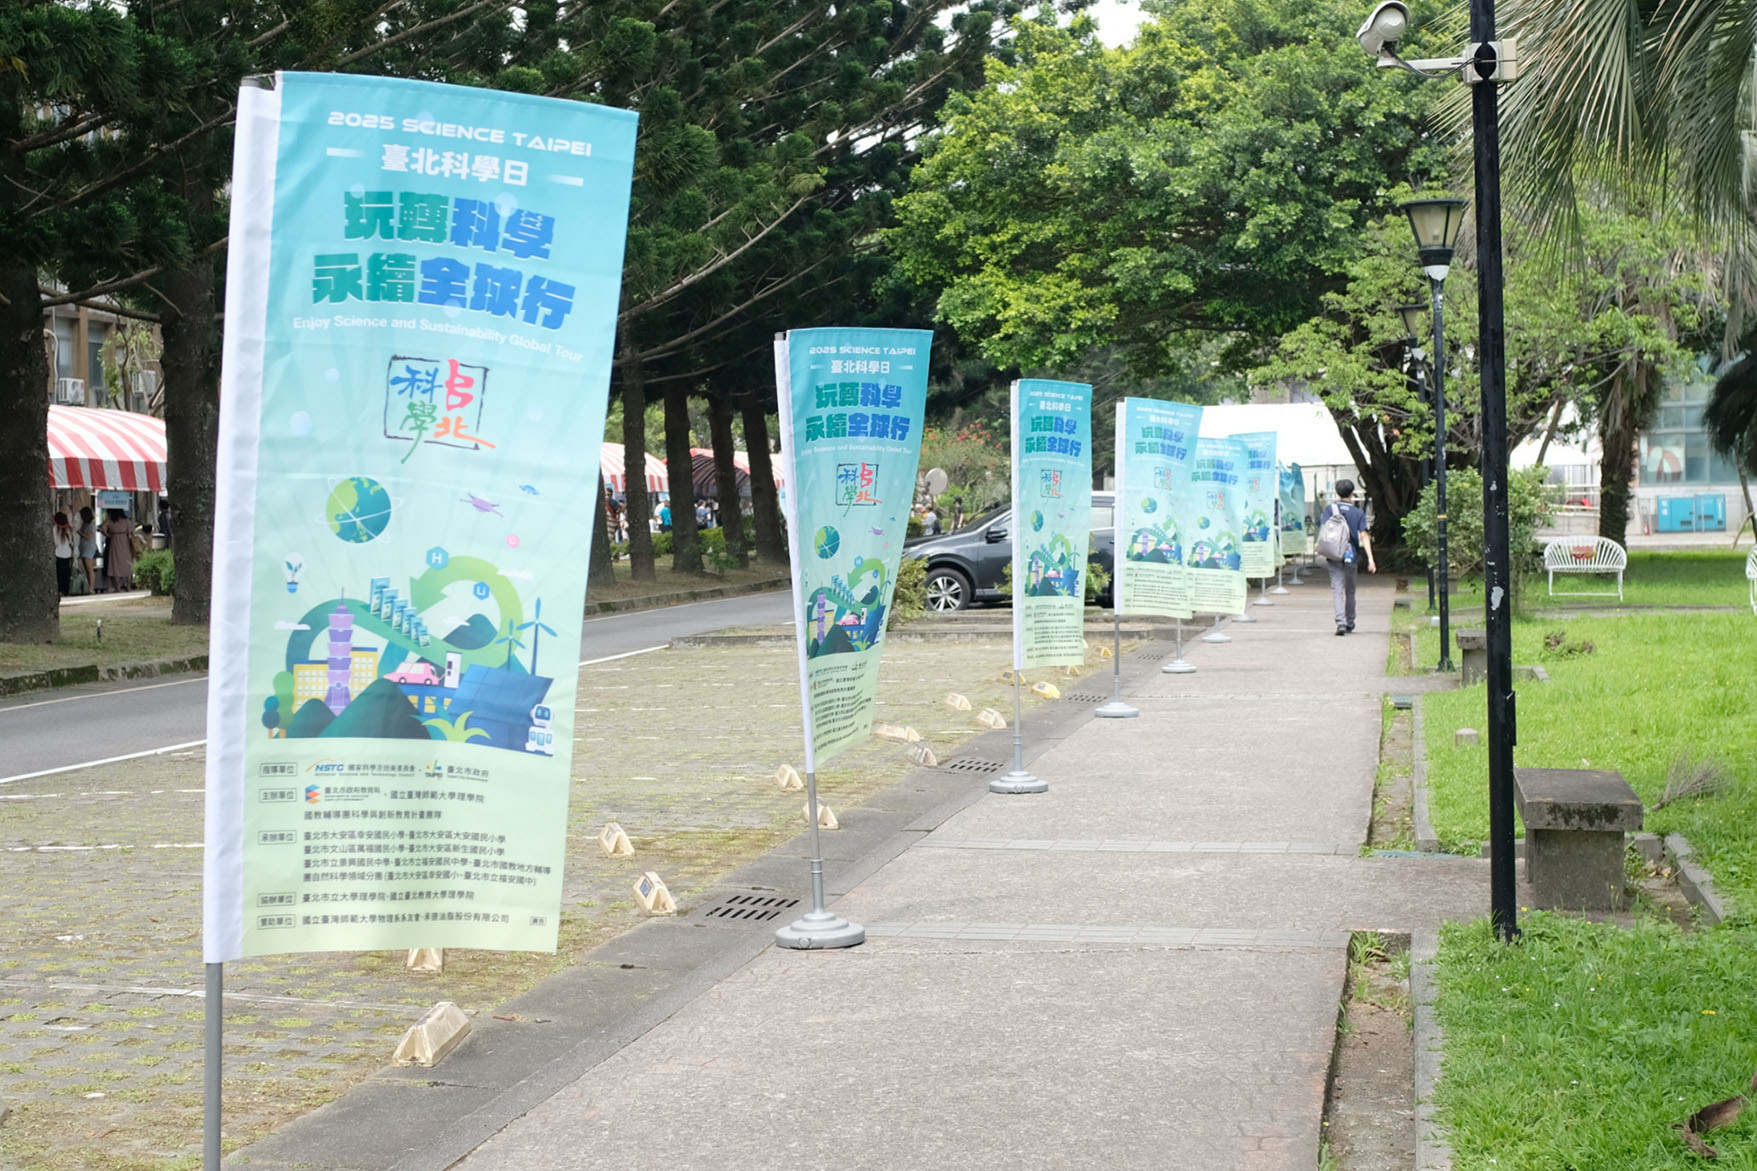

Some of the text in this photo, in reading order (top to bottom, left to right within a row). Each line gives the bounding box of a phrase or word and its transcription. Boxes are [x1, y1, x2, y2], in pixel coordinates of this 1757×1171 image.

[328, 111, 591, 157] 2025 SCIENCE TAIPEI
[381, 144, 529, 187] 臺北科學日
[343, 191, 556, 261] 玩轉科學
[312, 252, 576, 330] 永續全球行
[293, 315, 584, 362] Enjoy Science and Sustainability Global Tour
[831, 360, 890, 374] 臺北科學日
[315, 764, 344, 772] NSTC
